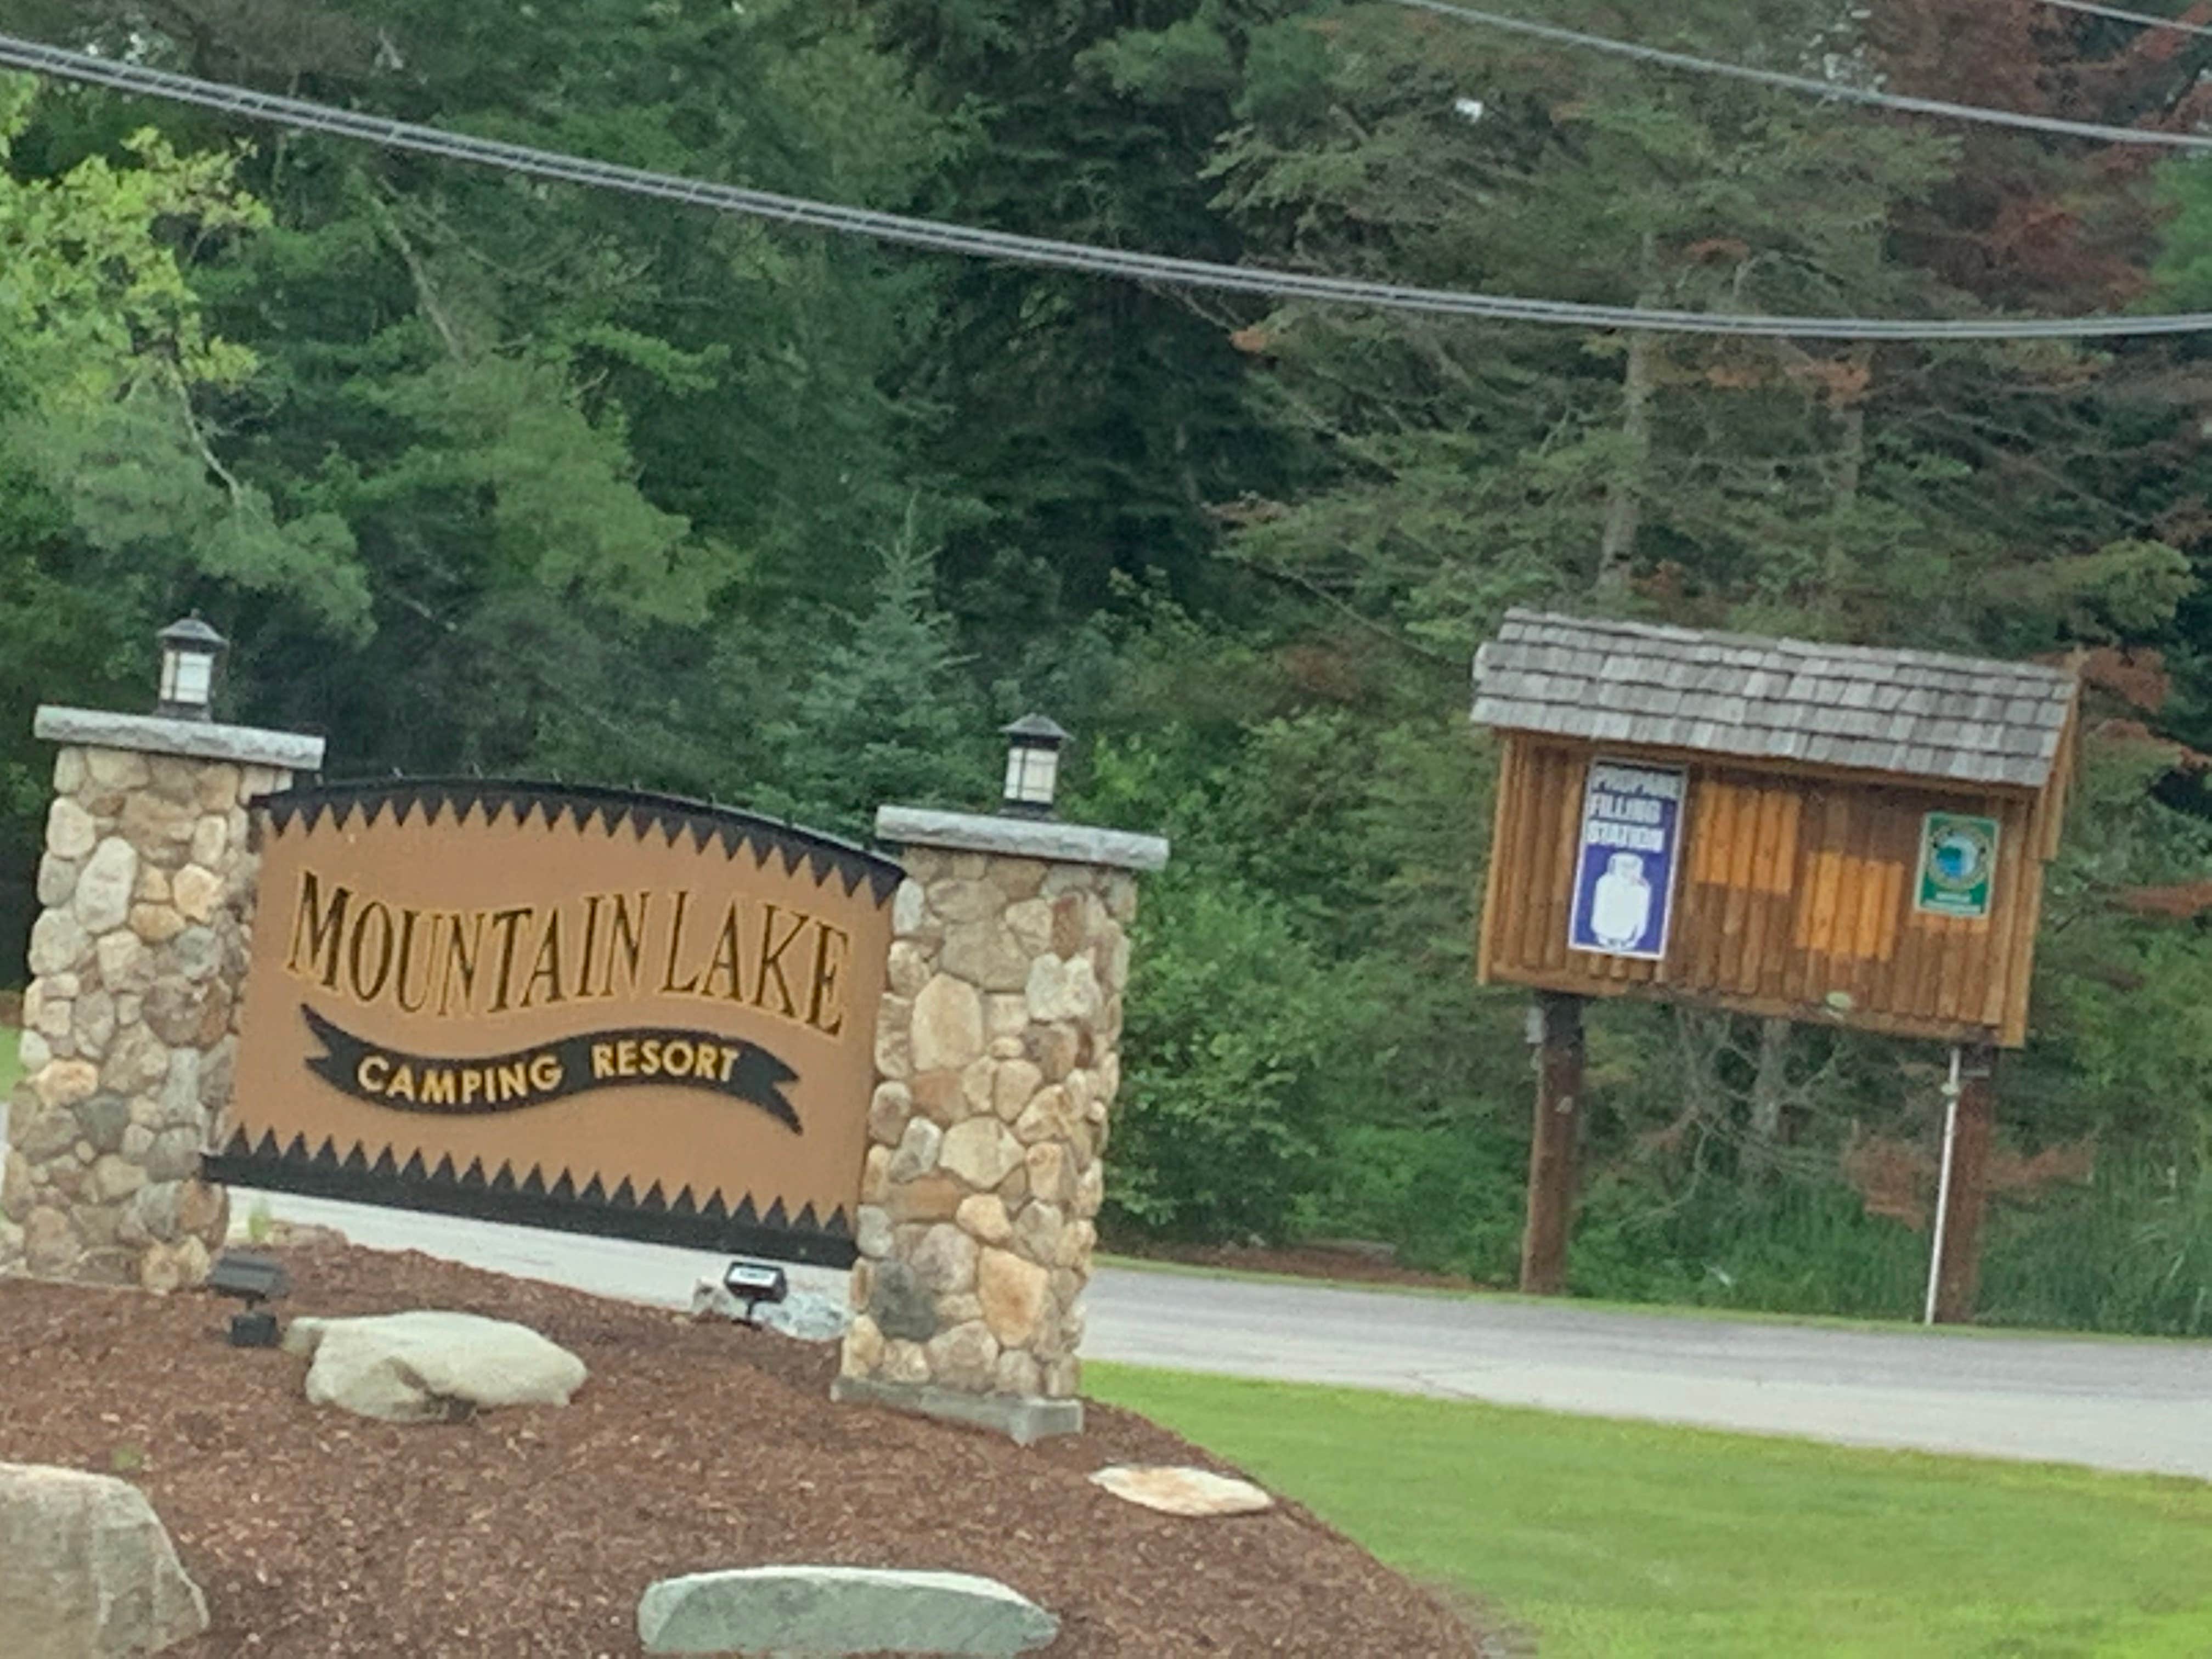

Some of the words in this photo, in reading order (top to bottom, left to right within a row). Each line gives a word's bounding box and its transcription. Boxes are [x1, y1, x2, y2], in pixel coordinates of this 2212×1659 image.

[285, 868, 651, 1018] MOUNTAIN
[659, 888, 850, 1038] LAKE
[357, 1054, 563, 1105] CAMPING
[591, 1040, 740, 1082] RESORT
